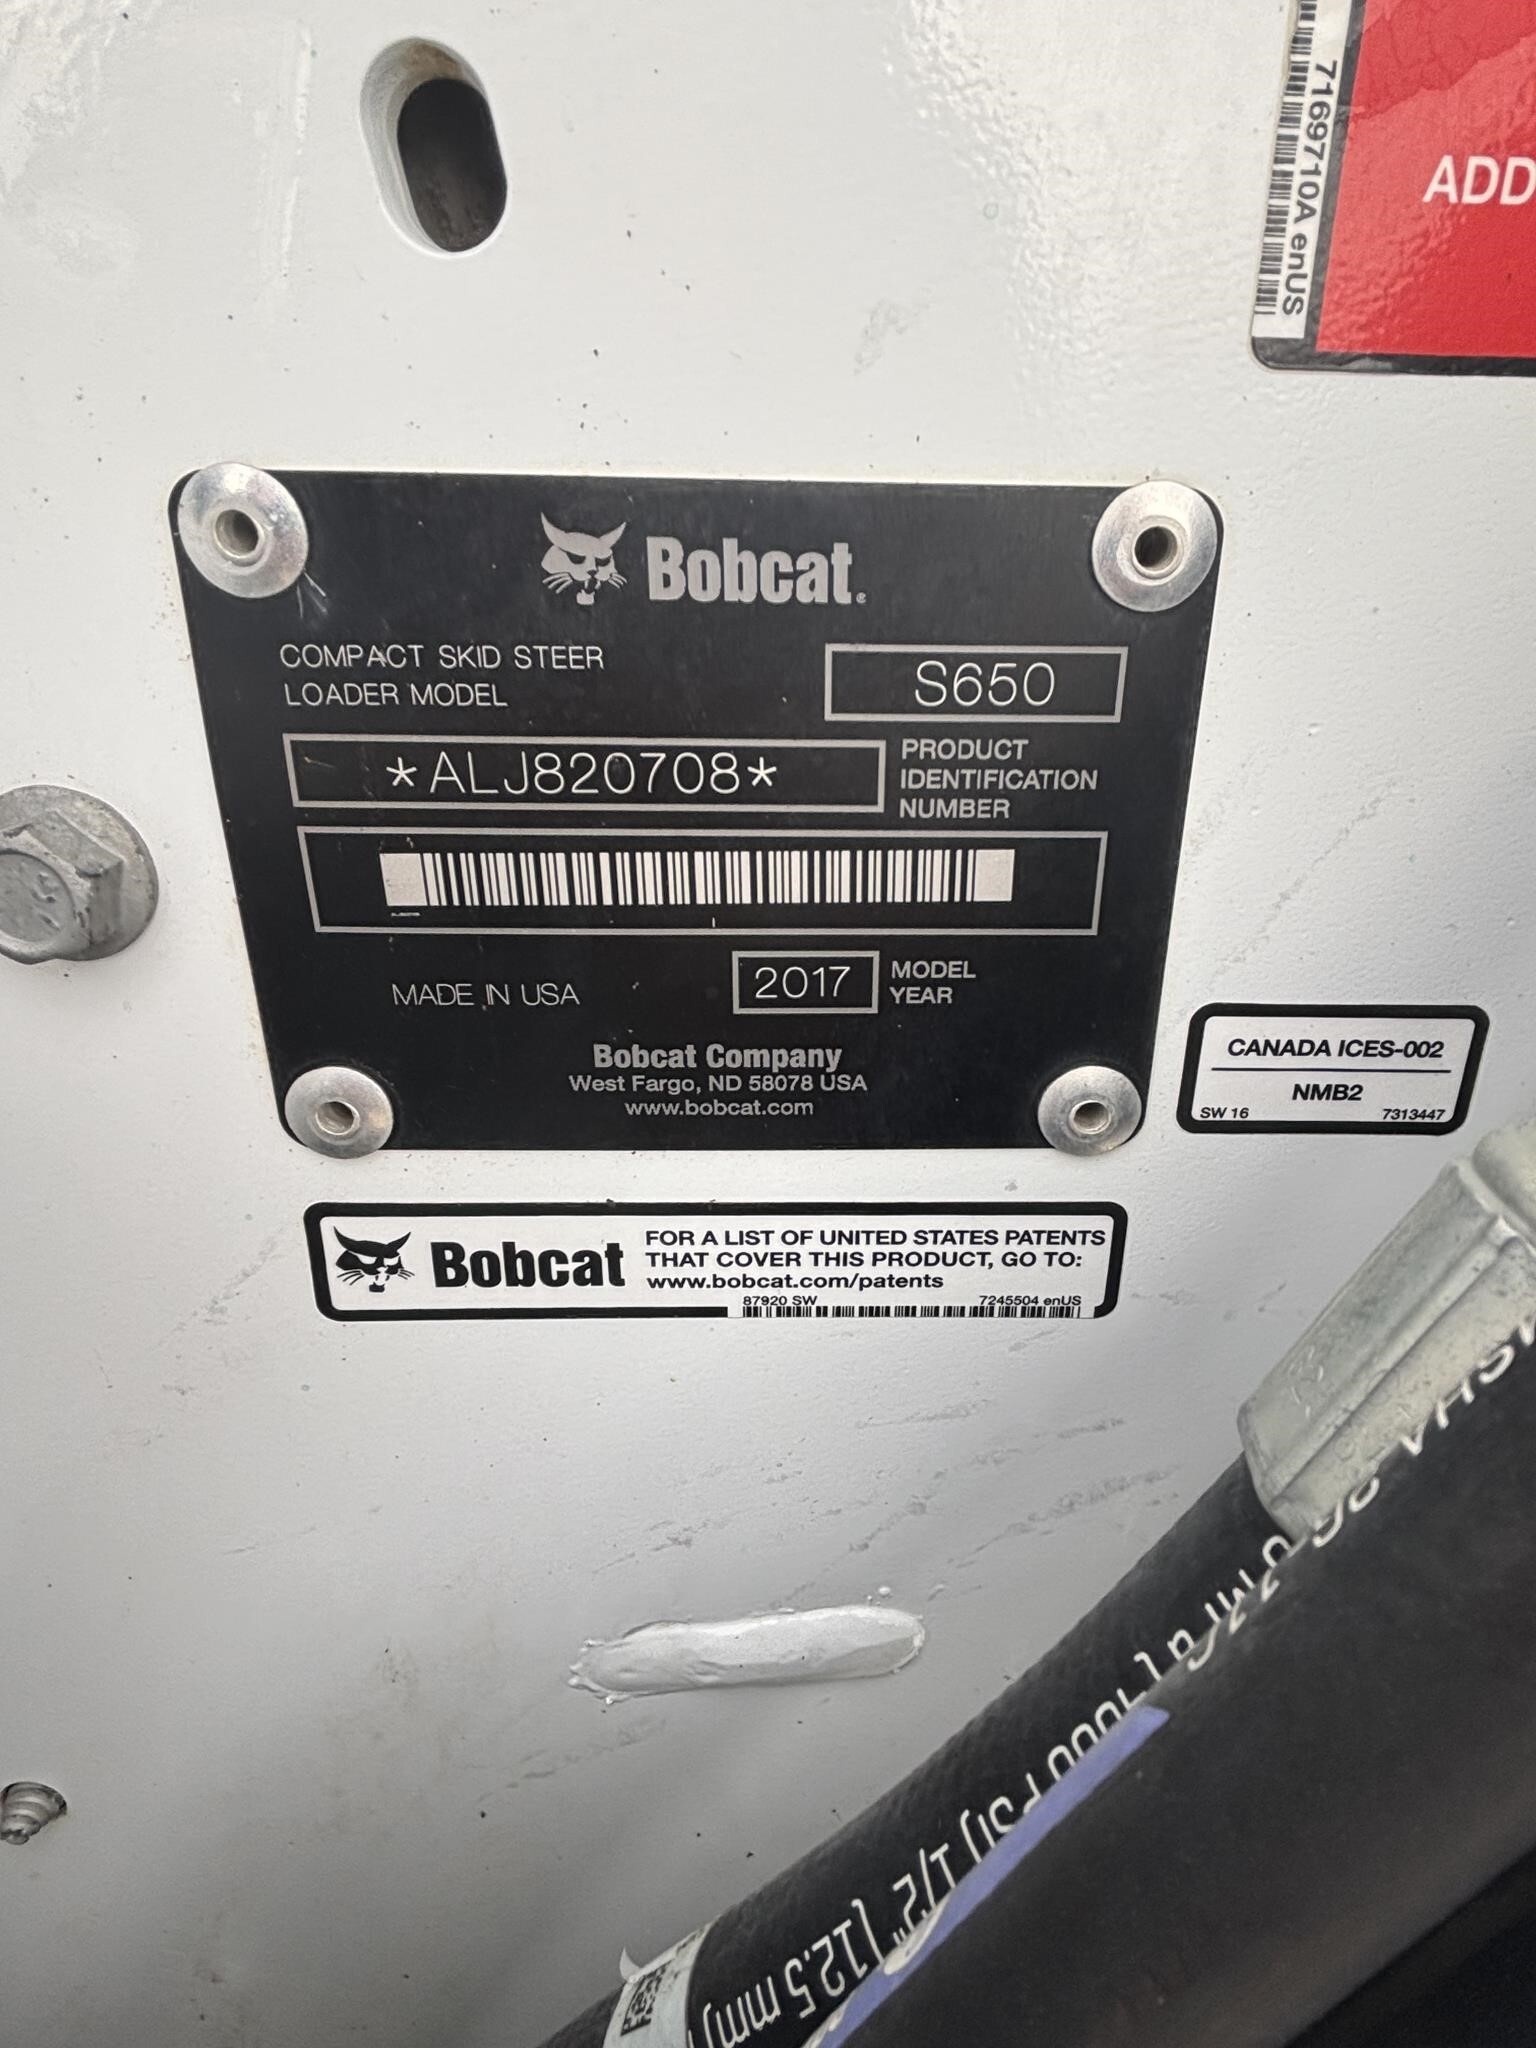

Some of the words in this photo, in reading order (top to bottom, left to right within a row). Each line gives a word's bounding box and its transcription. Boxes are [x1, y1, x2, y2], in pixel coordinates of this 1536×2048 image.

[1293, 59, 1337, 224] 7169710A
[1282, 232, 1308, 316] enUS
[646, 535, 853, 605] Bobcat
[279, 643, 424, 669] COMPACT
[438, 644, 501, 669] SKID
[514, 645, 604, 670] STEER
[284, 682, 400, 707] LOADER
[410, 682, 508, 707] MODEL
[915, 660, 1055, 707] S650
[901, 738, 1029, 761] PRODUCT
[900, 768, 1098, 790] IDENTIFICATION
[899, 798, 1011, 819] NUMBER
[891, 960, 977, 979] MODEL
[755, 966, 851, 999] 2017
[391, 983, 475, 1006] MADE
[485, 983, 510, 1006] IN
[520, 982, 580, 1006] USA
[889, 986, 953, 1004] YEAR
[593, 1043, 697, 1069] Bobcat
[705, 1043, 843, 1073] Company
[1227, 1038, 1332, 1057] CANADA
[1337, 1039, 1445, 1059] ICES-002
[568, 1074, 626, 1092] West
[631, 1074, 702, 1096] Fargo,
[708, 1074, 742, 1092] ND
[748, 1074, 814, 1092] 58078
[820, 1073, 868, 1092] USA
[1291, 1083, 1364, 1102] NMB2
[624, 1098, 814, 1116] www.bobcat.com
[1199, 1106, 1228, 1119] SW
[1231, 1107, 1250, 1119] 16
[1382, 1108, 1446, 1121] 7313447
[645, 1230, 695, 1246] FOR
[701, 1230, 719, 1246] A
[724, 1230, 776, 1246] LIST
[780, 1229, 814, 1246] OF
[819, 1229, 908, 1246] UNITED
[913, 1229, 999, 1246] STATES
[1005, 1229, 1106, 1246] PATENTS
[430, 1241, 626, 1288] Bobcat
[644, 1252, 710, 1268] THAT
[716, 1251, 802, 1268] COVER
[808, 1251, 865, 1267] THIS
[871, 1251, 994, 1270] PRODUCT,
[1001, 1251, 1037, 1268] GO
[1043, 1251, 1082, 1268] TO:
[646, 1272, 944, 1292] www.bobcat.com/patents
[742, 1295, 788, 1306] 87920
[791, 1295, 818, 1306] SW
[979, 1295, 1040, 1306] 7245504
[1043, 1295, 1082, 1306] enUS
[799, 1898, 886, 2020] (12.5
